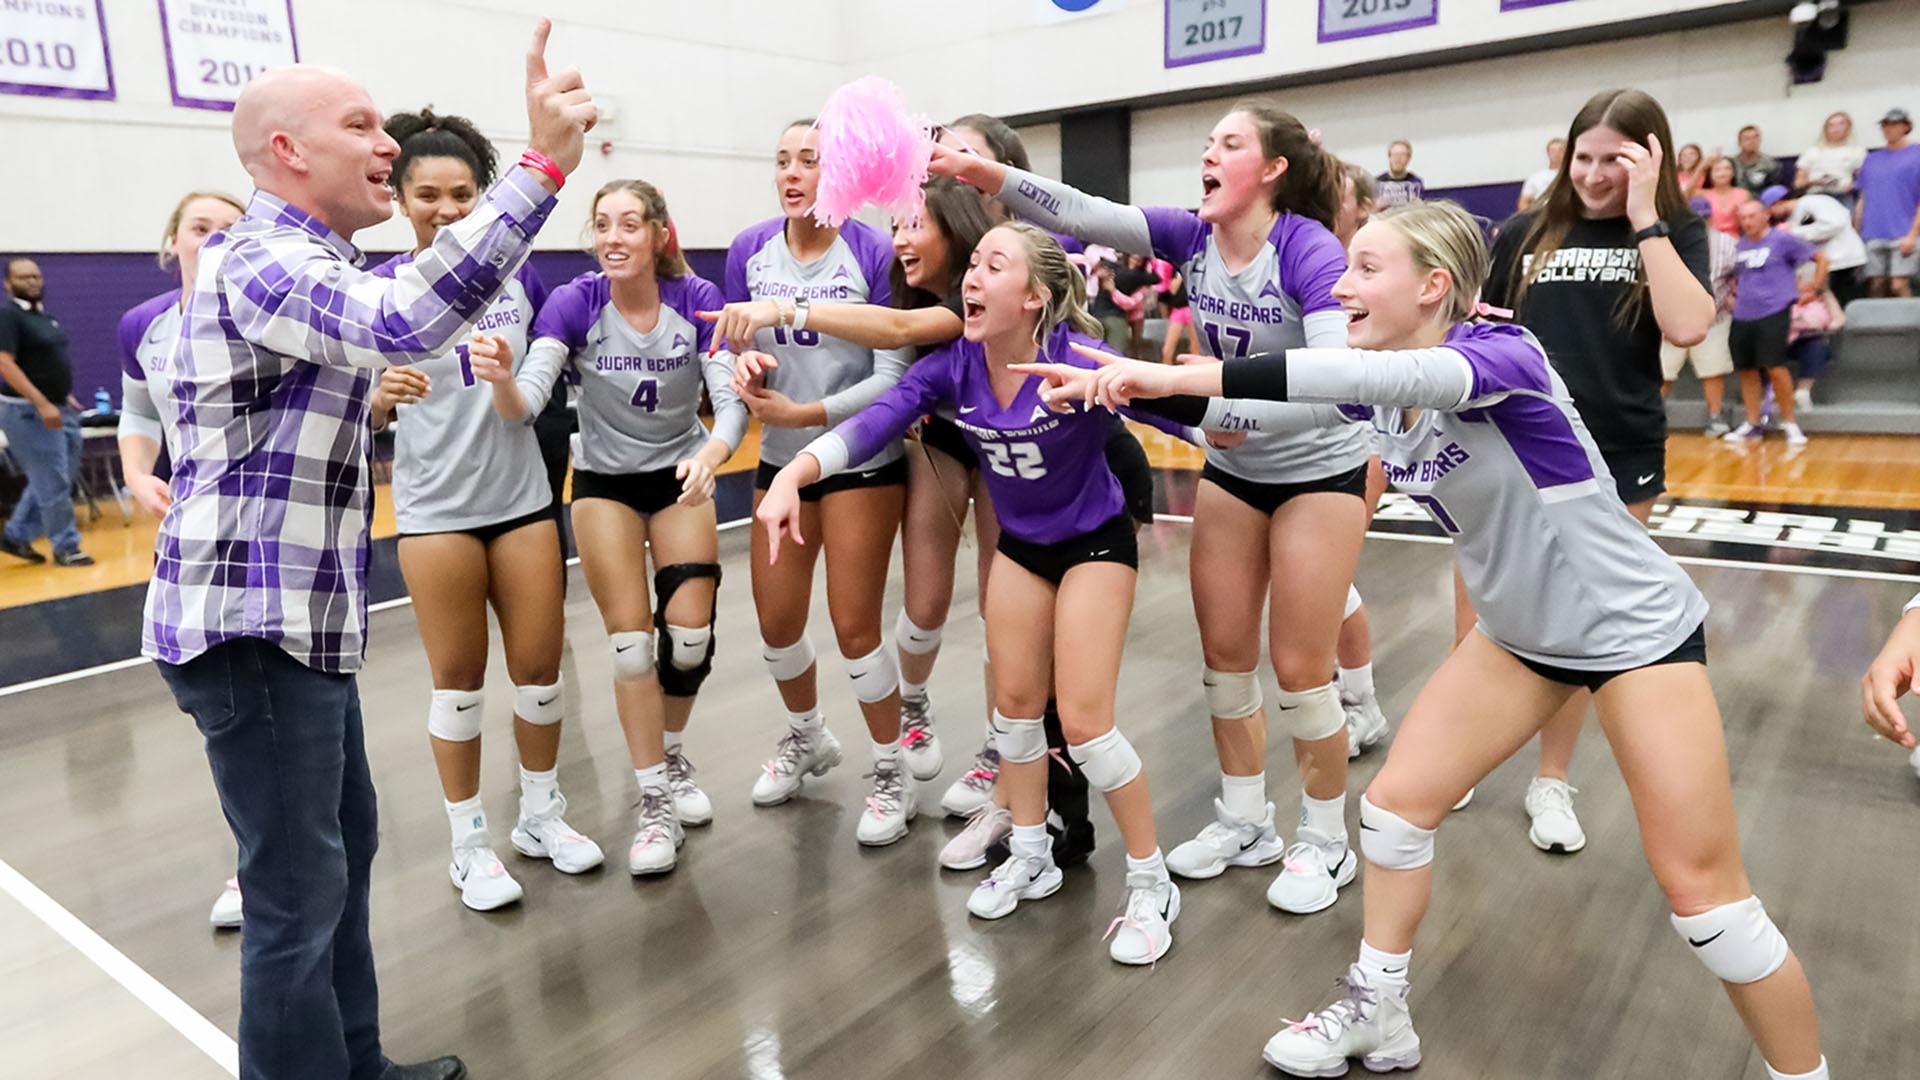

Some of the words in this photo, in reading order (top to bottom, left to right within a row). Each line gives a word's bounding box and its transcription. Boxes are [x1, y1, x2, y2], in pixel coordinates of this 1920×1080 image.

[190, 2, 268, 25] DIVISION
[178, 19, 283, 43] CHAMPIONS
[1185, 15, 1243, 46] 2017
[0, 38, 76, 71] 010
[199, 58, 266, 86] 201
[1018, 179, 1060, 216] CENTRAL
[755, 280, 798, 299] SUGAR
[801, 285, 848, 299] BEARS
[1524, 266, 1649, 285] OLLEYBAL
[1188, 284, 1226, 316] SGAR
[1229, 302, 1283, 325] BEARS
[477, 308, 521, 331] BEARS
[1203, 321, 1252, 361] 17
[596, 355, 642, 371] SUGAR
[646, 352, 690, 372] BEARS
[630, 378, 660, 414] 4
[980, 441, 1048, 480] 22
